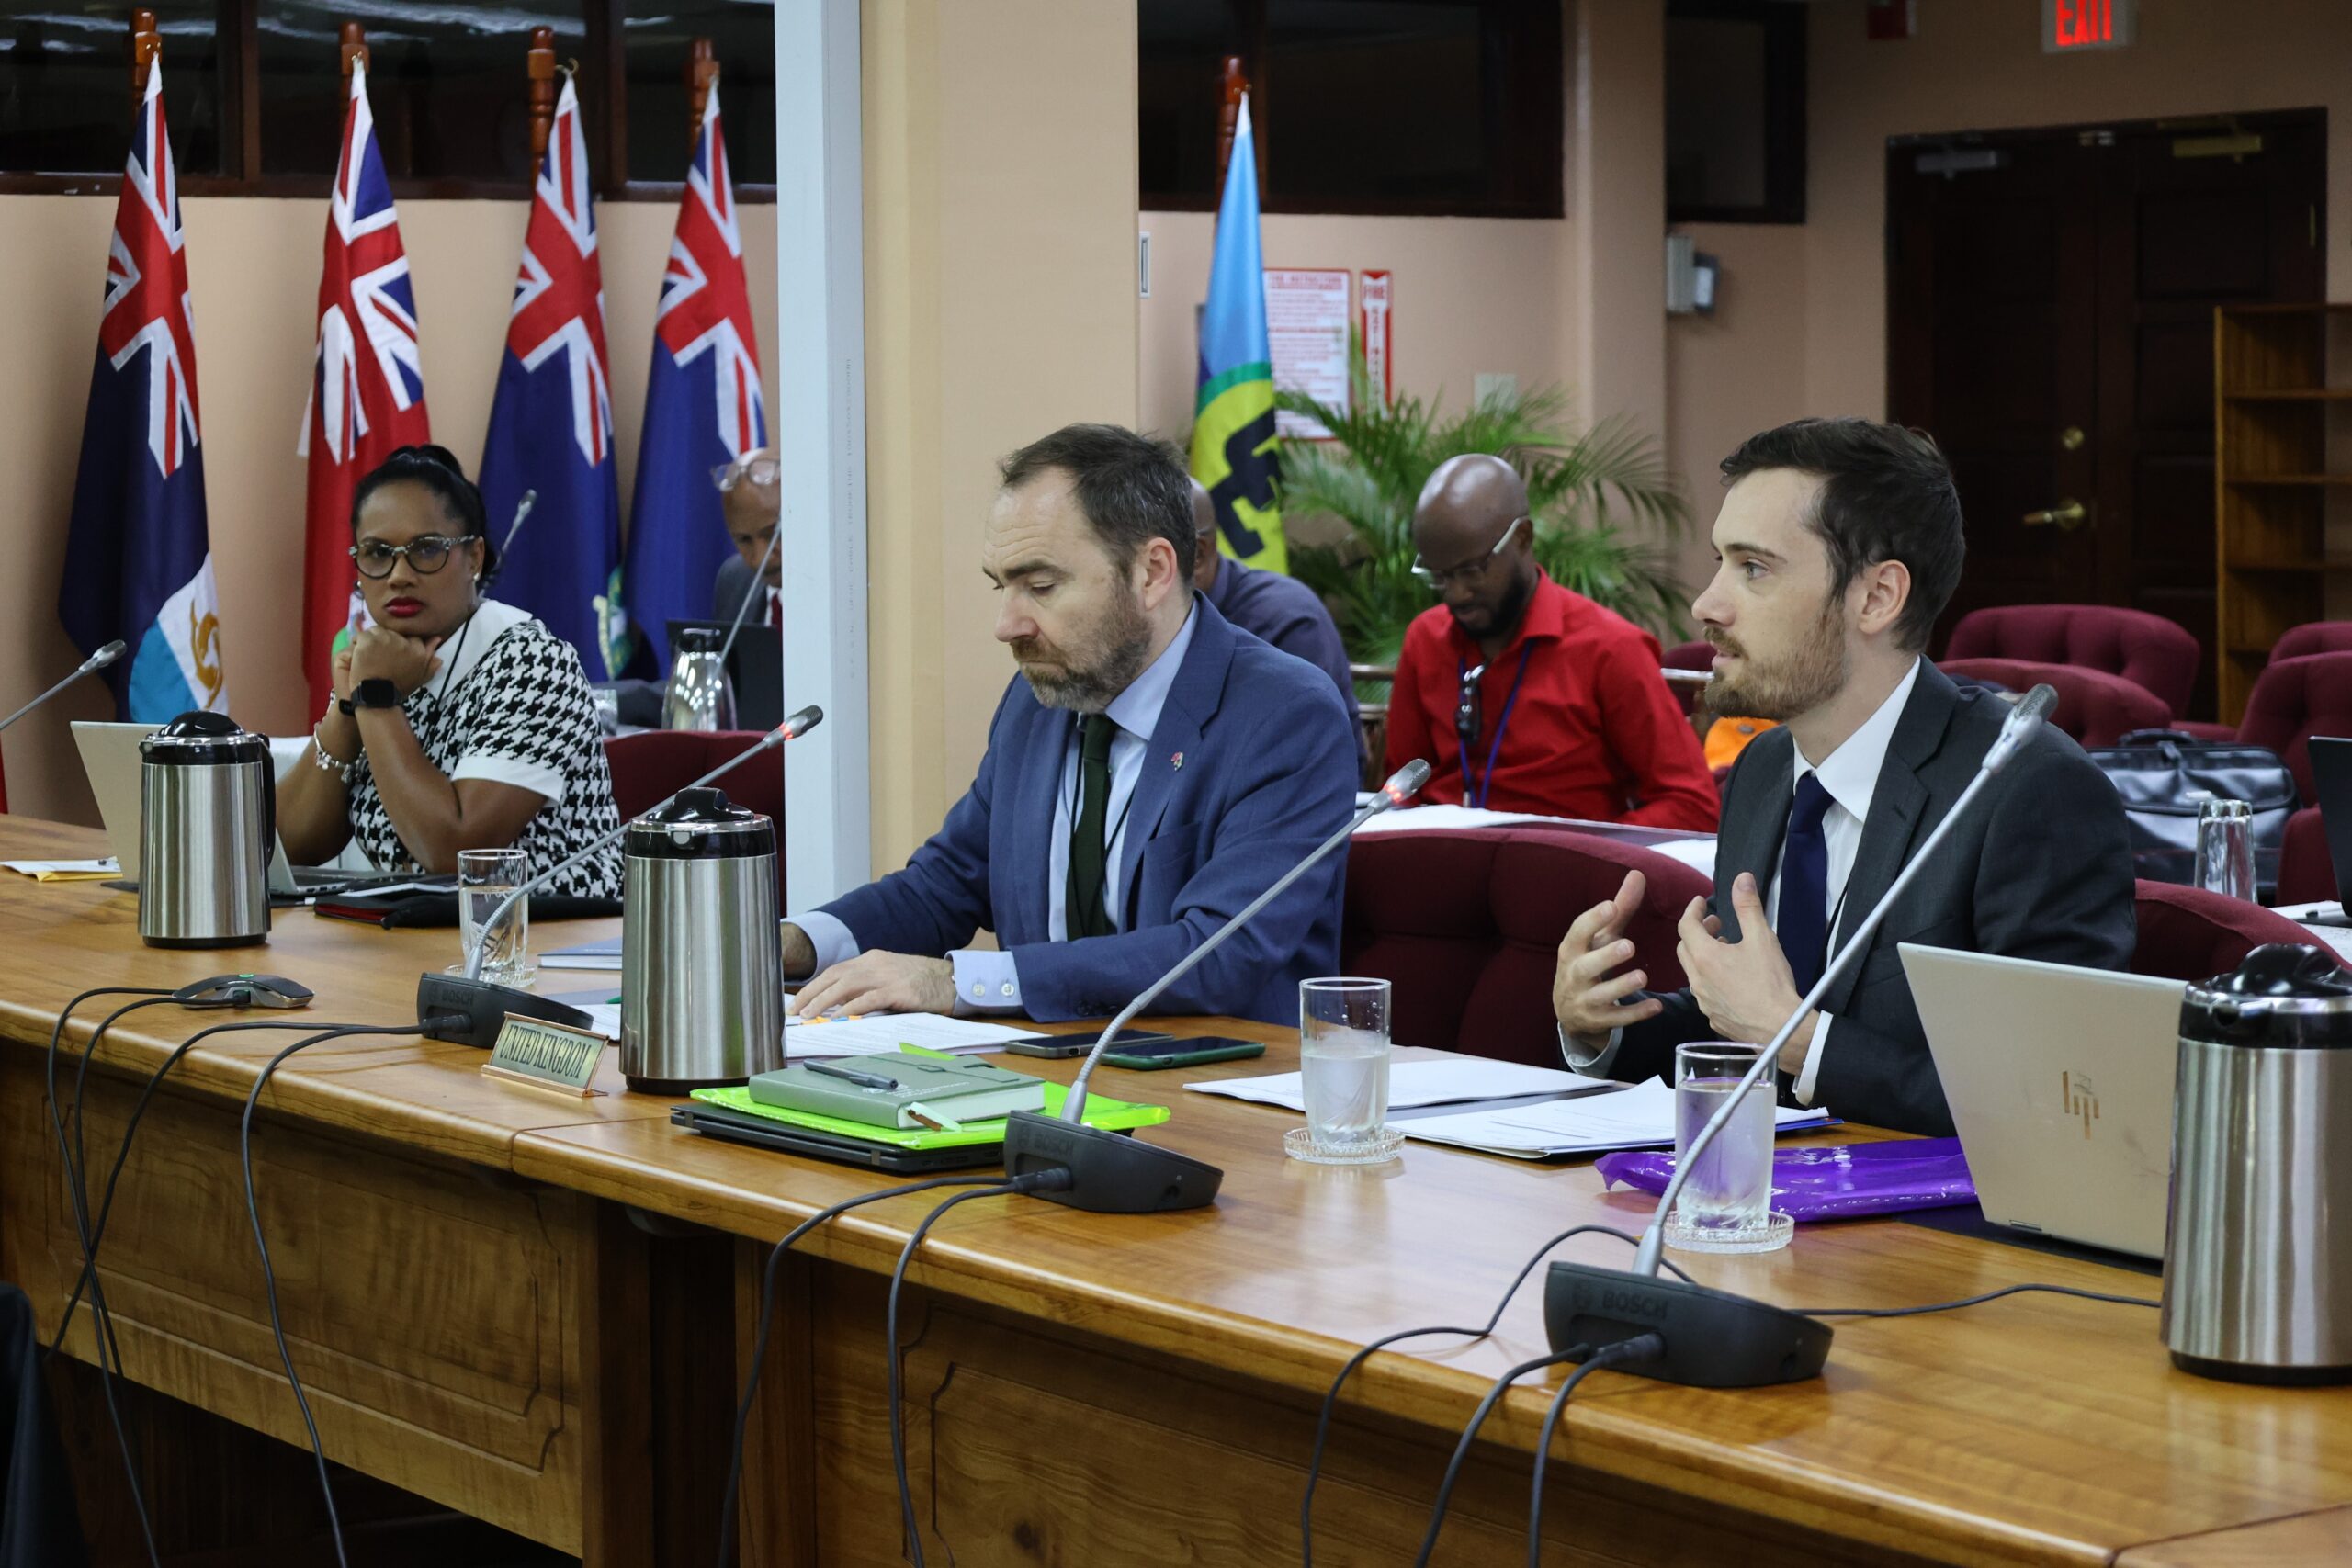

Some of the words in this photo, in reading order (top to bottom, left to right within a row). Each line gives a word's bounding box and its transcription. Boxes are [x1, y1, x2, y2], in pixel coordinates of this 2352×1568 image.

[441, 988, 475, 1006] BOSCH
[499, 1024, 542, 1066] UNITED
[533, 1033, 593, 1078] KINGDOM
[1034, 1133, 1075, 1155] BOSCH
[1601, 1290, 1669, 1320] BOSCH
